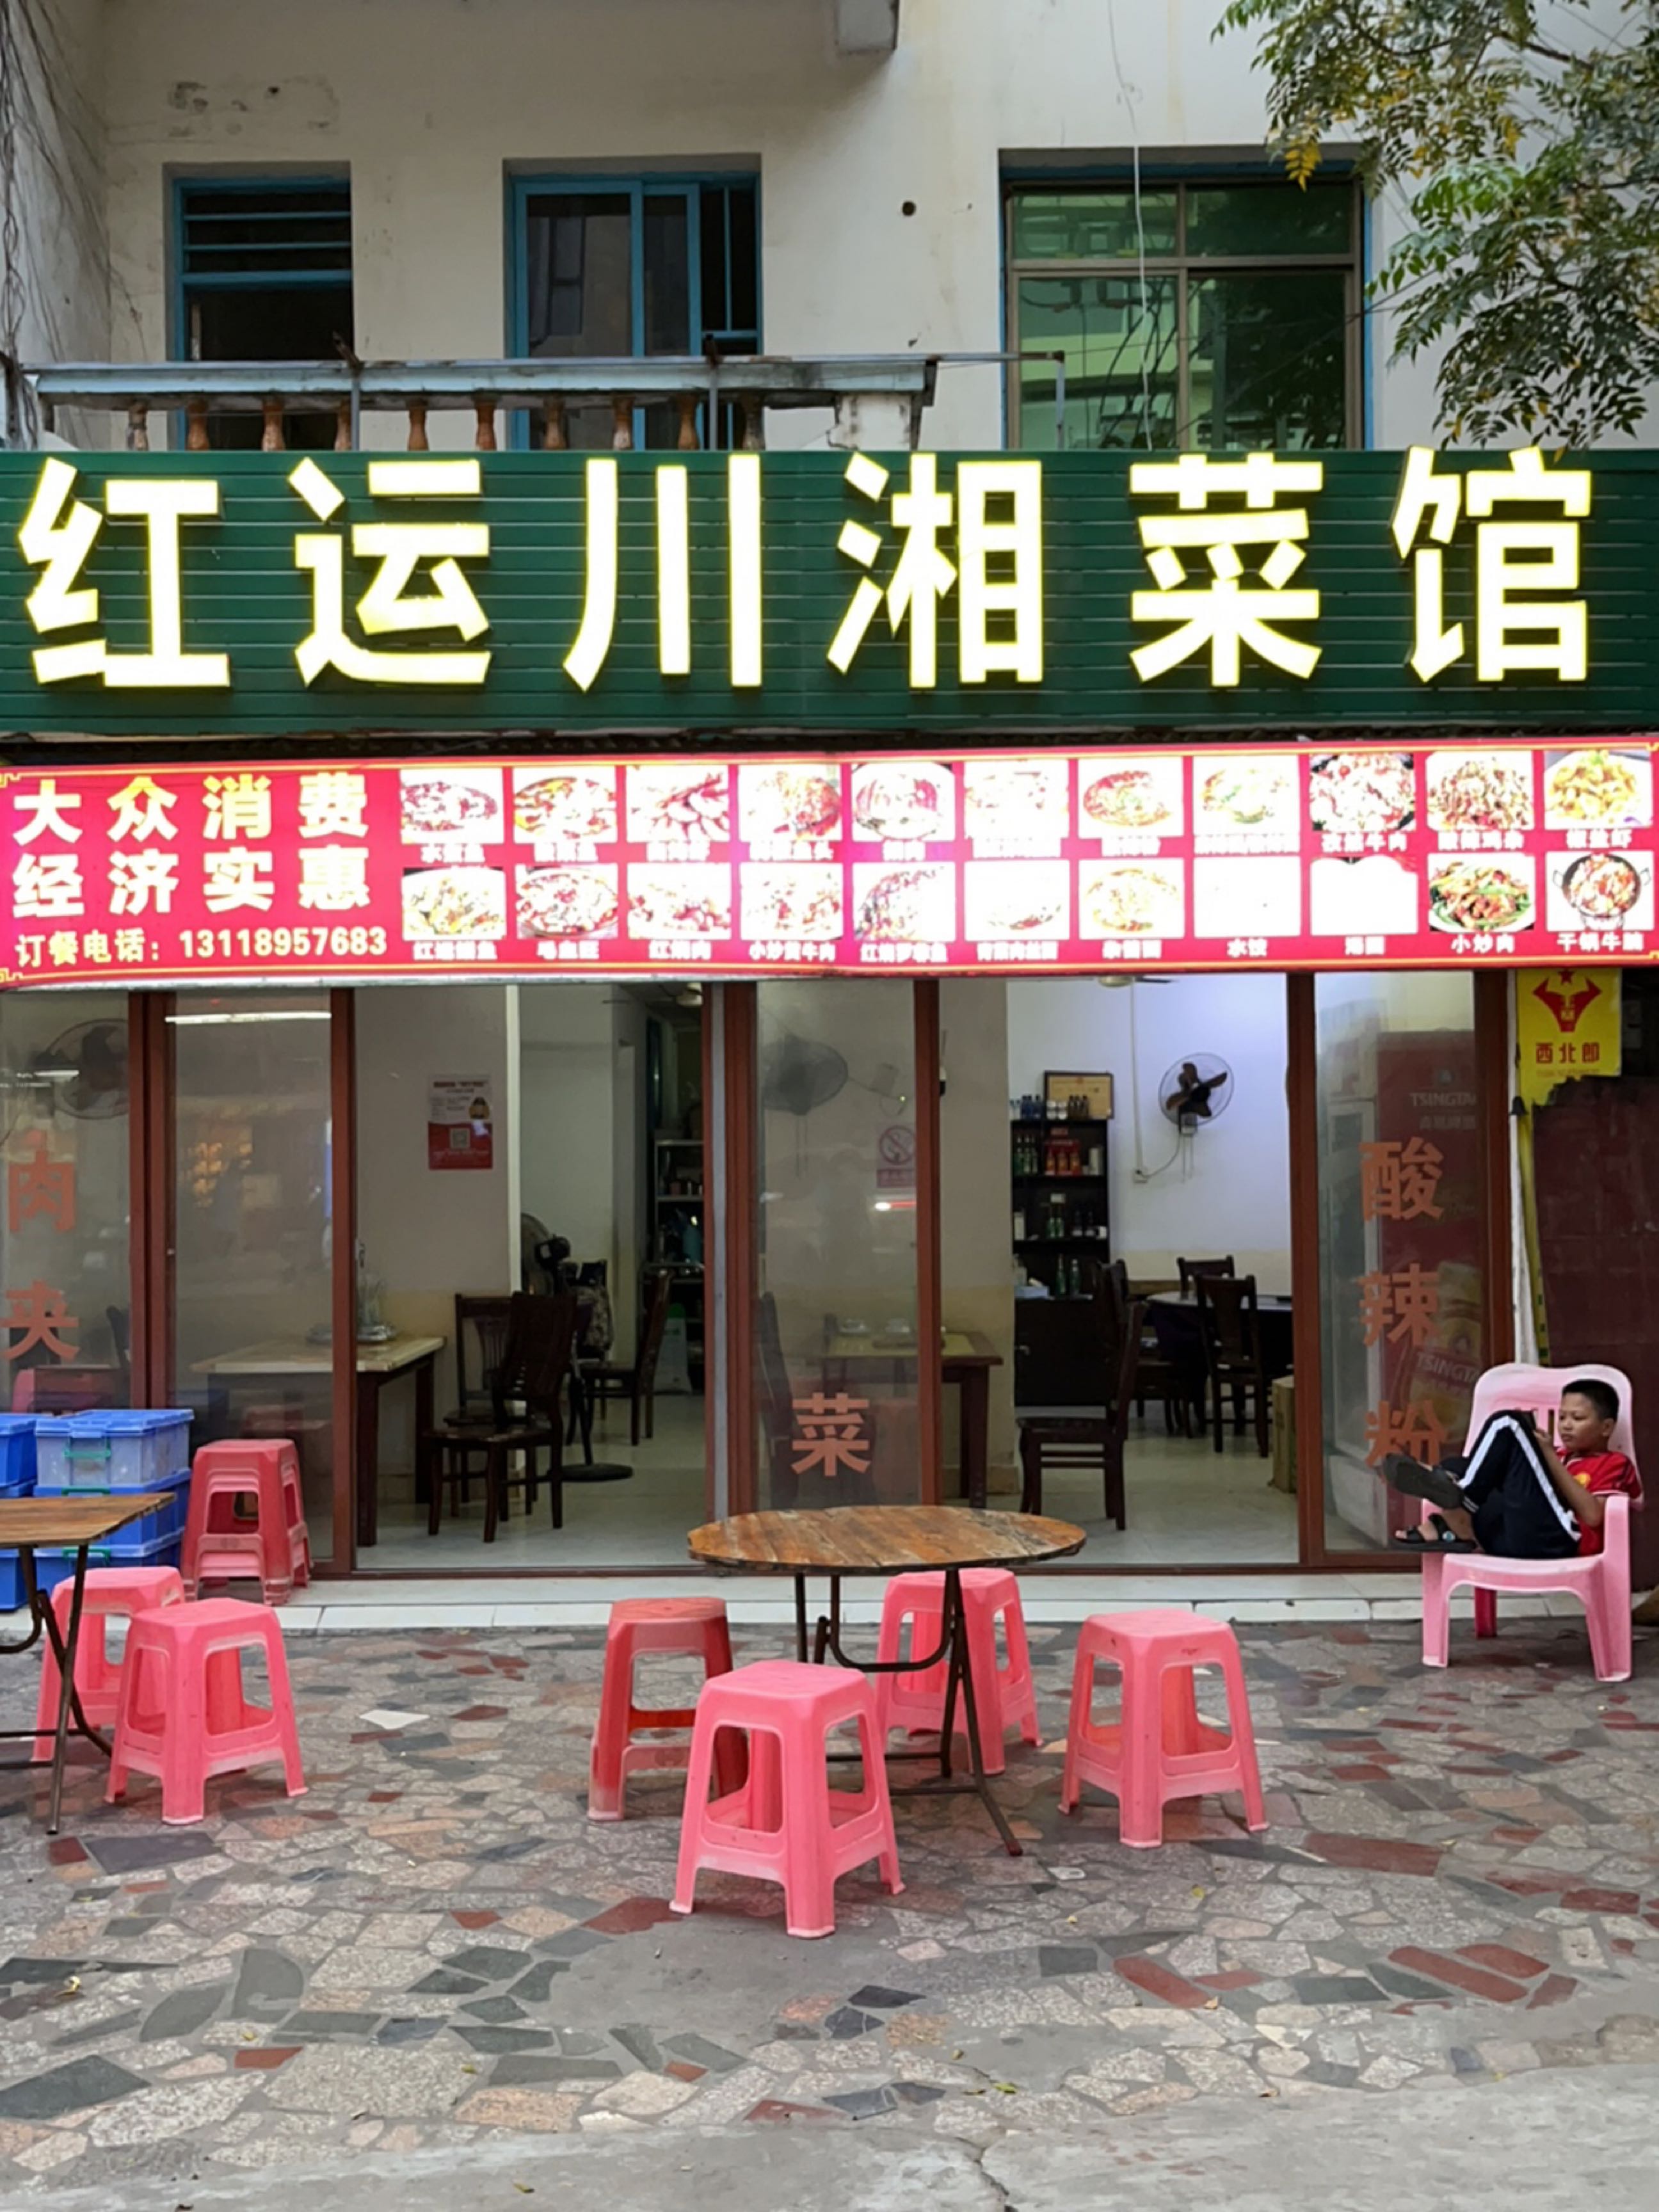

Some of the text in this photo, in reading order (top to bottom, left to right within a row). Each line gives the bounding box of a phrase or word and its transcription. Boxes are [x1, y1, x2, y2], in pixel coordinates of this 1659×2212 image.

[18, 447, 1592, 690] 红运川湘菜馆
[12, 771, 369, 845] 大众消费
[12, 844, 371, 918] 经济实惠
[1410, 1092, 1477, 1107] TSINGTA
[1358, 1137, 1448, 1469] 酸辣粉
[790, 1392, 871, 1477] 菜
